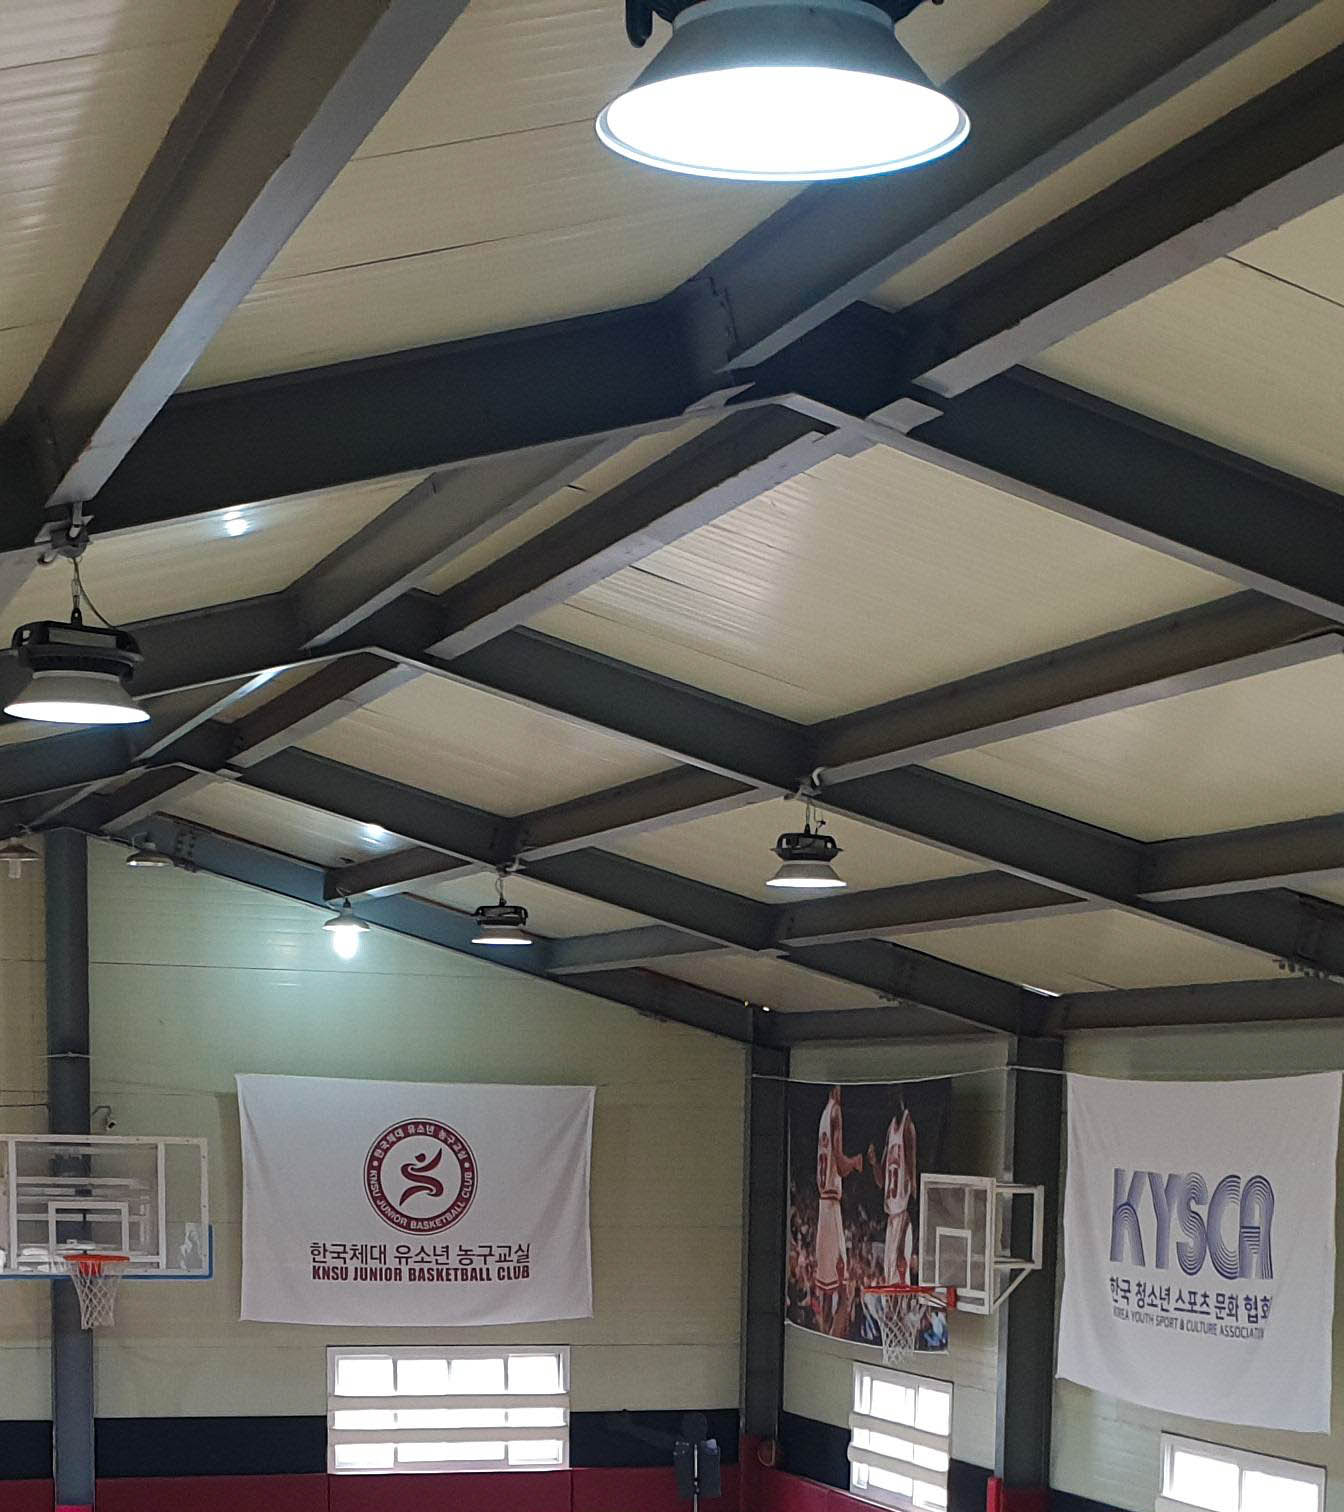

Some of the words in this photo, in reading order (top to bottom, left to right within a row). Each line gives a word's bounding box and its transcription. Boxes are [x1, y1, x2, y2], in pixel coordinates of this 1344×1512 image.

[1110, 1168, 1274, 1280] KYSCA
[310, 1242, 387, 1265] 한국체대
[394, 1244, 450, 1266] 유소년
[456, 1243, 531, 1266] 농구교실
[312, 1265, 349, 1281] KNSU
[353, 1266, 402, 1282] JUNIOR
[408, 1266, 492, 1282] BASKETBALL
[497, 1265, 530, 1281] CLUB
[1110, 1276, 1131, 1306] 한국
[1135, 1281, 1171, 1313] 청소년
[1173, 1288, 1211, 1315] 스포츠
[1214, 1292, 1239, 1323] 문화
